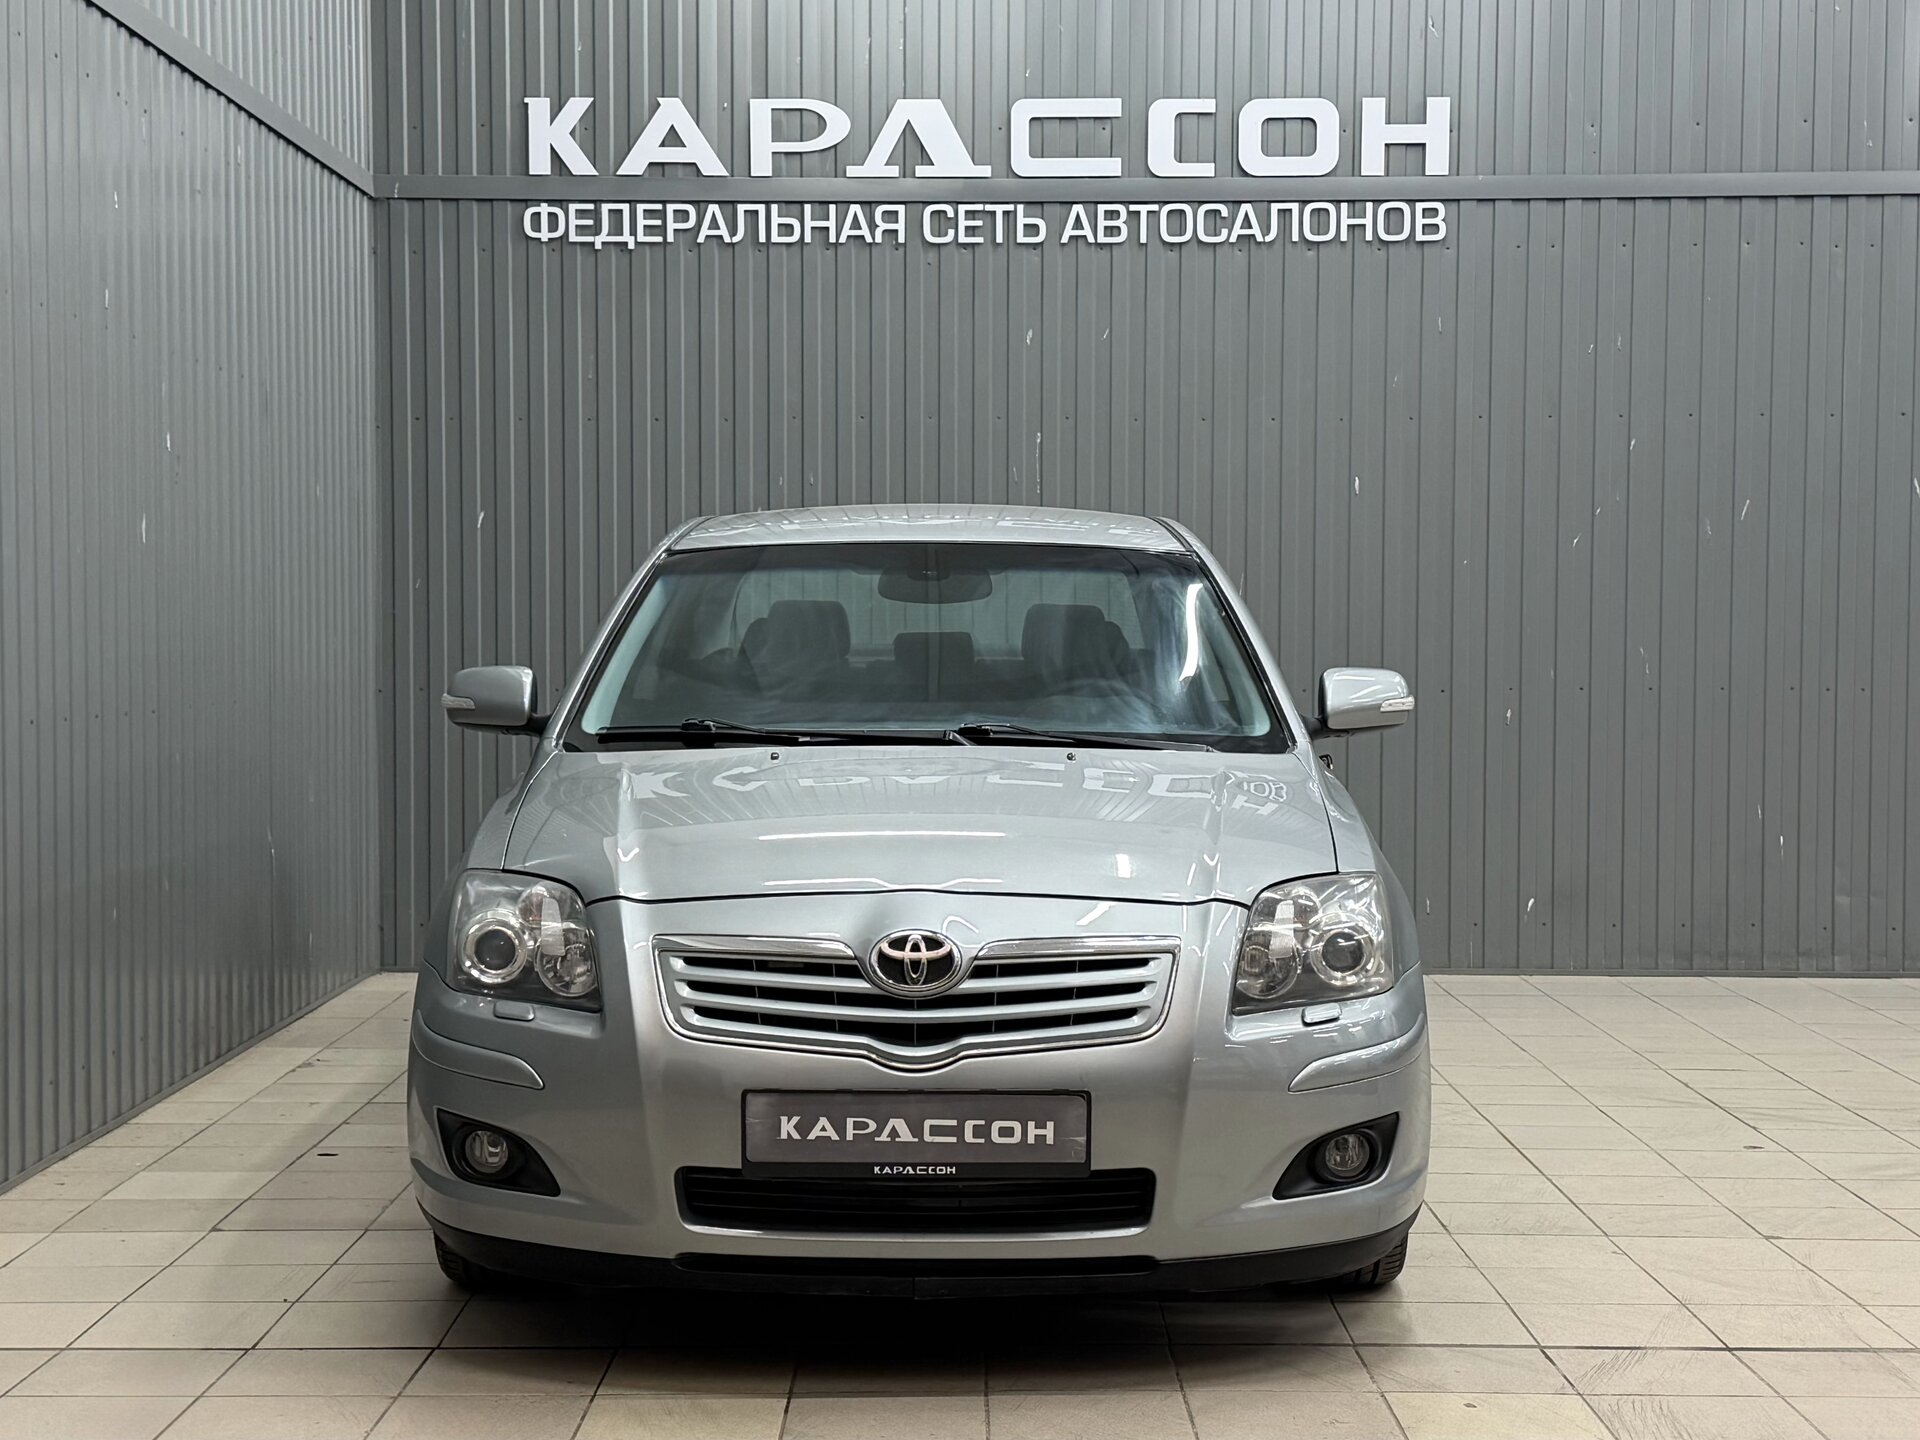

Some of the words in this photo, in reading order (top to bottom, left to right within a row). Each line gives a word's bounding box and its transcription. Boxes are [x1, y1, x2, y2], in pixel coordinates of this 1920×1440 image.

[523, 201, 907, 250] ФЕДЕРАЛЬНАЯ
[922, 202, 1047, 245] СЕТЬ
[1060, 200, 1448, 245] АВТОСАЛОНОВ
